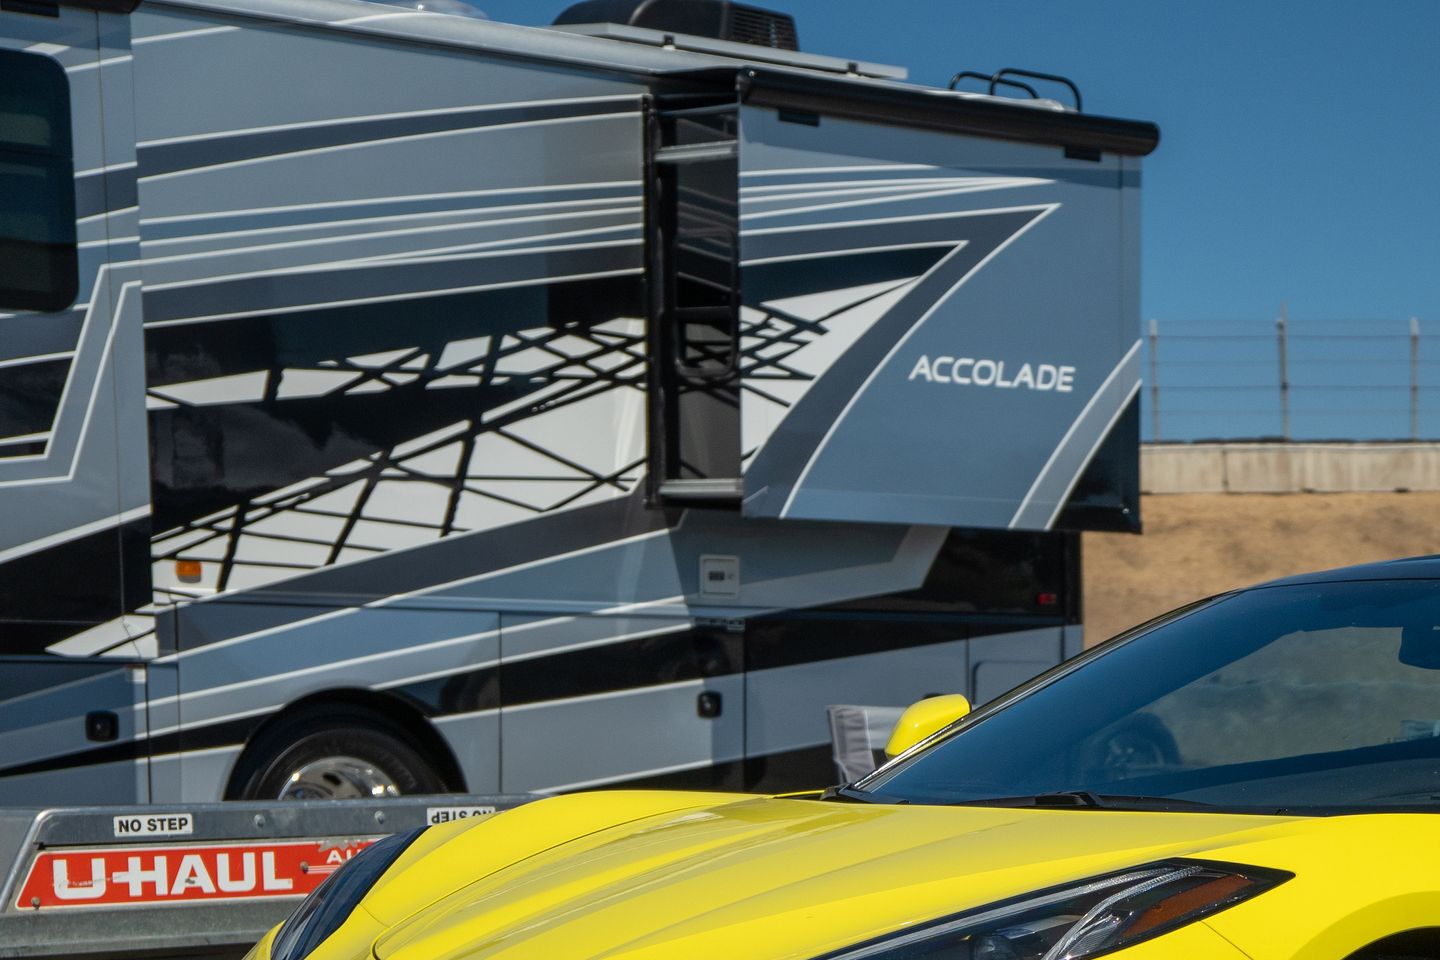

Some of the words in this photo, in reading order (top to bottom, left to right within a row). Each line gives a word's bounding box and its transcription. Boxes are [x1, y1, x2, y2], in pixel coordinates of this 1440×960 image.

[908, 354, 1076, 392] ACCOLADE
[118, 818, 141, 832] NO
[147, 817, 188, 831] STEP
[52, 851, 293, 899] U-HAUL
